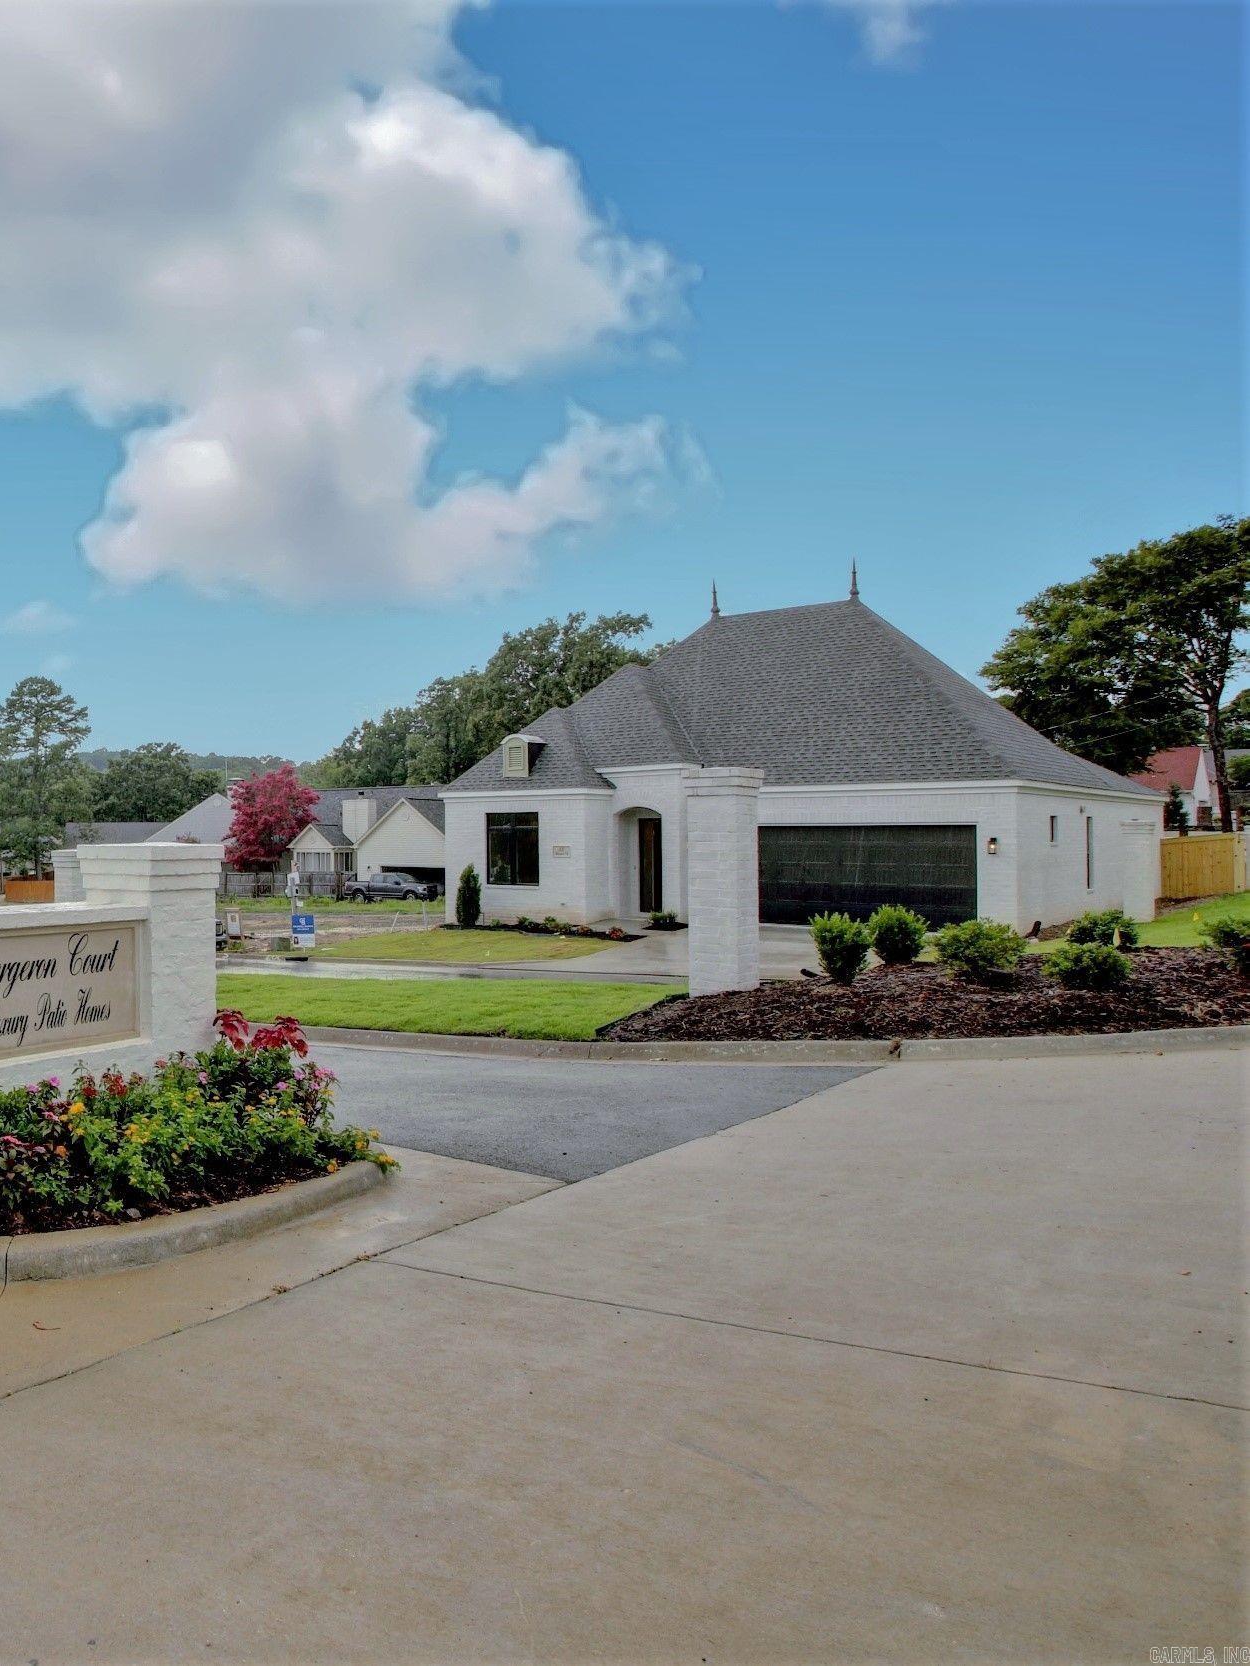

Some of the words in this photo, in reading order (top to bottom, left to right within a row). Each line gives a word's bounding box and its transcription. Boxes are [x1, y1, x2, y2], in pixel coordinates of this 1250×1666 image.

[68, 933, 119, 976] Court
[34, 992, 67, 1031] Patio
[74, 986, 111, 1025] Homes
